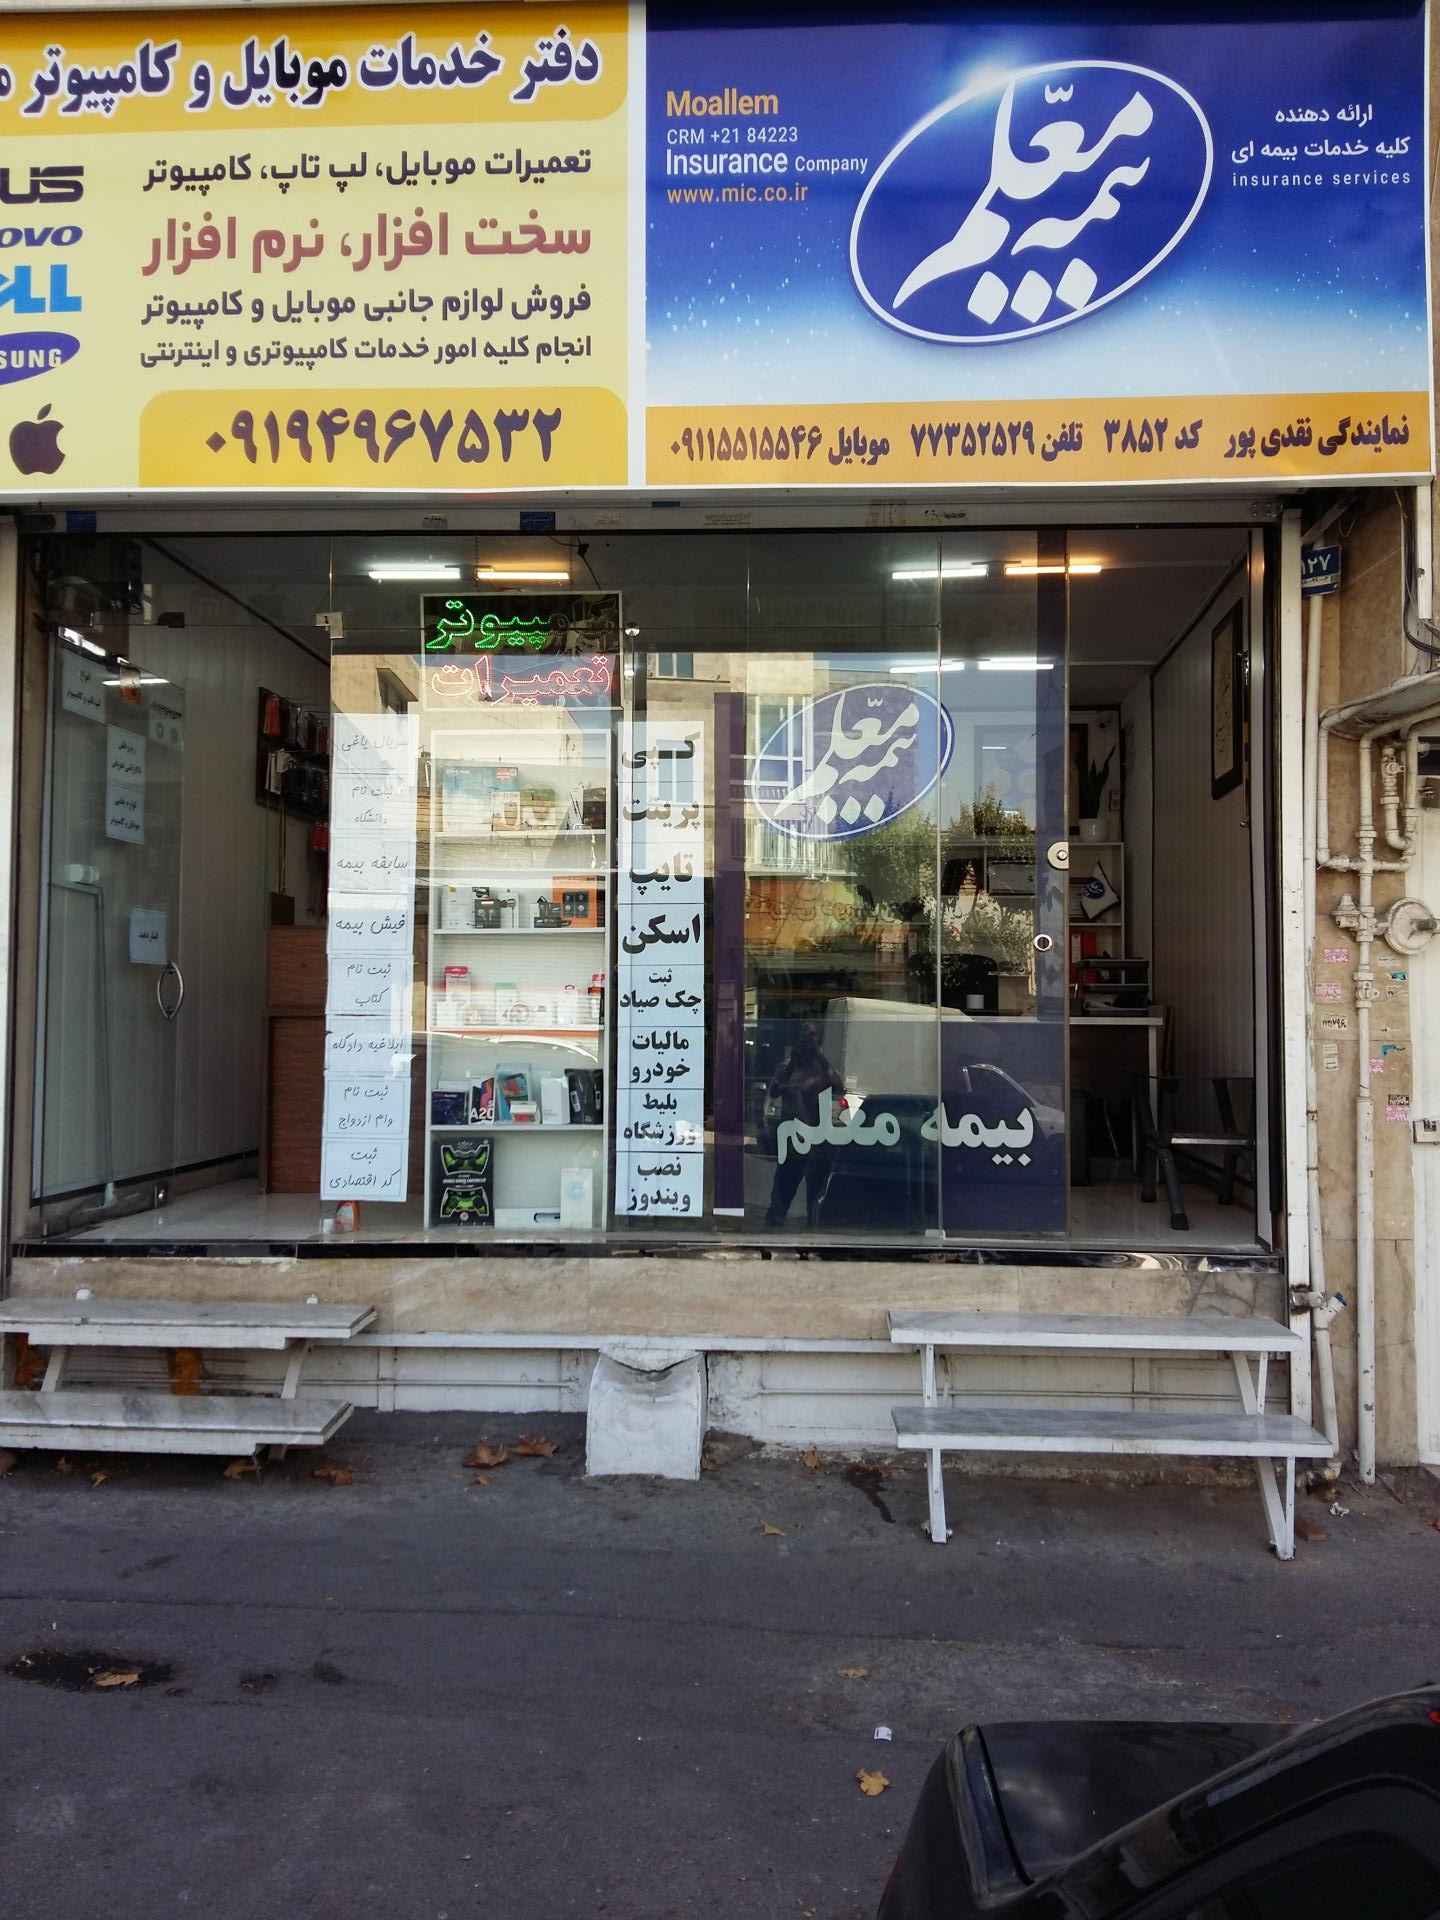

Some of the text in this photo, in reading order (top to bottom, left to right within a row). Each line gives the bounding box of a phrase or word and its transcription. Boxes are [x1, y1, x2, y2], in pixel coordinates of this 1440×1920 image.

[224, 37, 348, 107] موبایل
[361, 33, 501, 88] خدمات
[512, 26, 600, 101] دفتر
[23, 43, 178, 115] کامپیوتر
[188, 65, 212, 108] و
[666, 88, 779, 117] Moallem
[1275, 103, 1373, 127] ارائه دهنده
[667, 126, 798, 145] CRM +21 84223
[666, 148, 868, 175] Insurance Company
[1231, 135, 1412, 164] کلیه خدمات بیمه ای
[142, 147, 591, 197] تعمیرات موبایل، لپ تاپ، کامپیوتر
[1232, 170, 1411, 187] insurance services
[667, 182, 808, 204] www.mic.co.ir
[141, 206, 592, 276] سخت افزار، نرم افزار
[141, 283, 592, 331] فروش لوازم جانبی موبایل و کامپیوتر
[140, 334, 592, 371] انجام کلیه امور خدمات کامپیوتری و اینترنتی
[204, 406, 563, 464] ۰۹۱۹۴۹۶۷۵۳۲
[670, 414, 1410, 466] نمایندگی نقدی پور کد ۳۸۵۲ تلفن ۷۷۳۵۲۵۲۹ موبایل ۰۹۱۱۵۵۱۵۵۴۶
[431, 654, 612, 706] تعمیرات
[342, 733, 368, 751] یاغی
[621, 730, 701, 770] کپی
[622, 796, 701, 831] پرینت
[336, 854, 409, 875] سابقه بیمه
[628, 851, 694, 896] تایپ
[335, 913, 406, 935] فیش بیمه
[621, 913, 702, 955] اسکن
[346, 962, 392, 979] ثبت نام
[648, 967, 673, 984] ثبت
[355, 987, 390, 1010] کتاب
[619, 989, 702, 1015] چک صیاد
[332, 1032, 404, 1055] ابلاغیه دادگاه
[631, 1030, 690, 1055] مالیات
[629, 1058, 691, 1084] خودرو
[344, 1084, 389, 1101] ثبت نام
[642, 1092, 678, 1116] بلیط
[338, 1112, 394, 1129] وام ازدواج
[623, 1120, 697, 1146] ورزشگاه
[776, 1085, 1034, 1167] بیمه معلم
[350, 1147, 378, 1162] ثبت
[329, 1169, 401, 1189] کد اقتصادی
[637, 1156, 682, 1182] نصب
[627, 1188, 691, 1212] ویندوز
